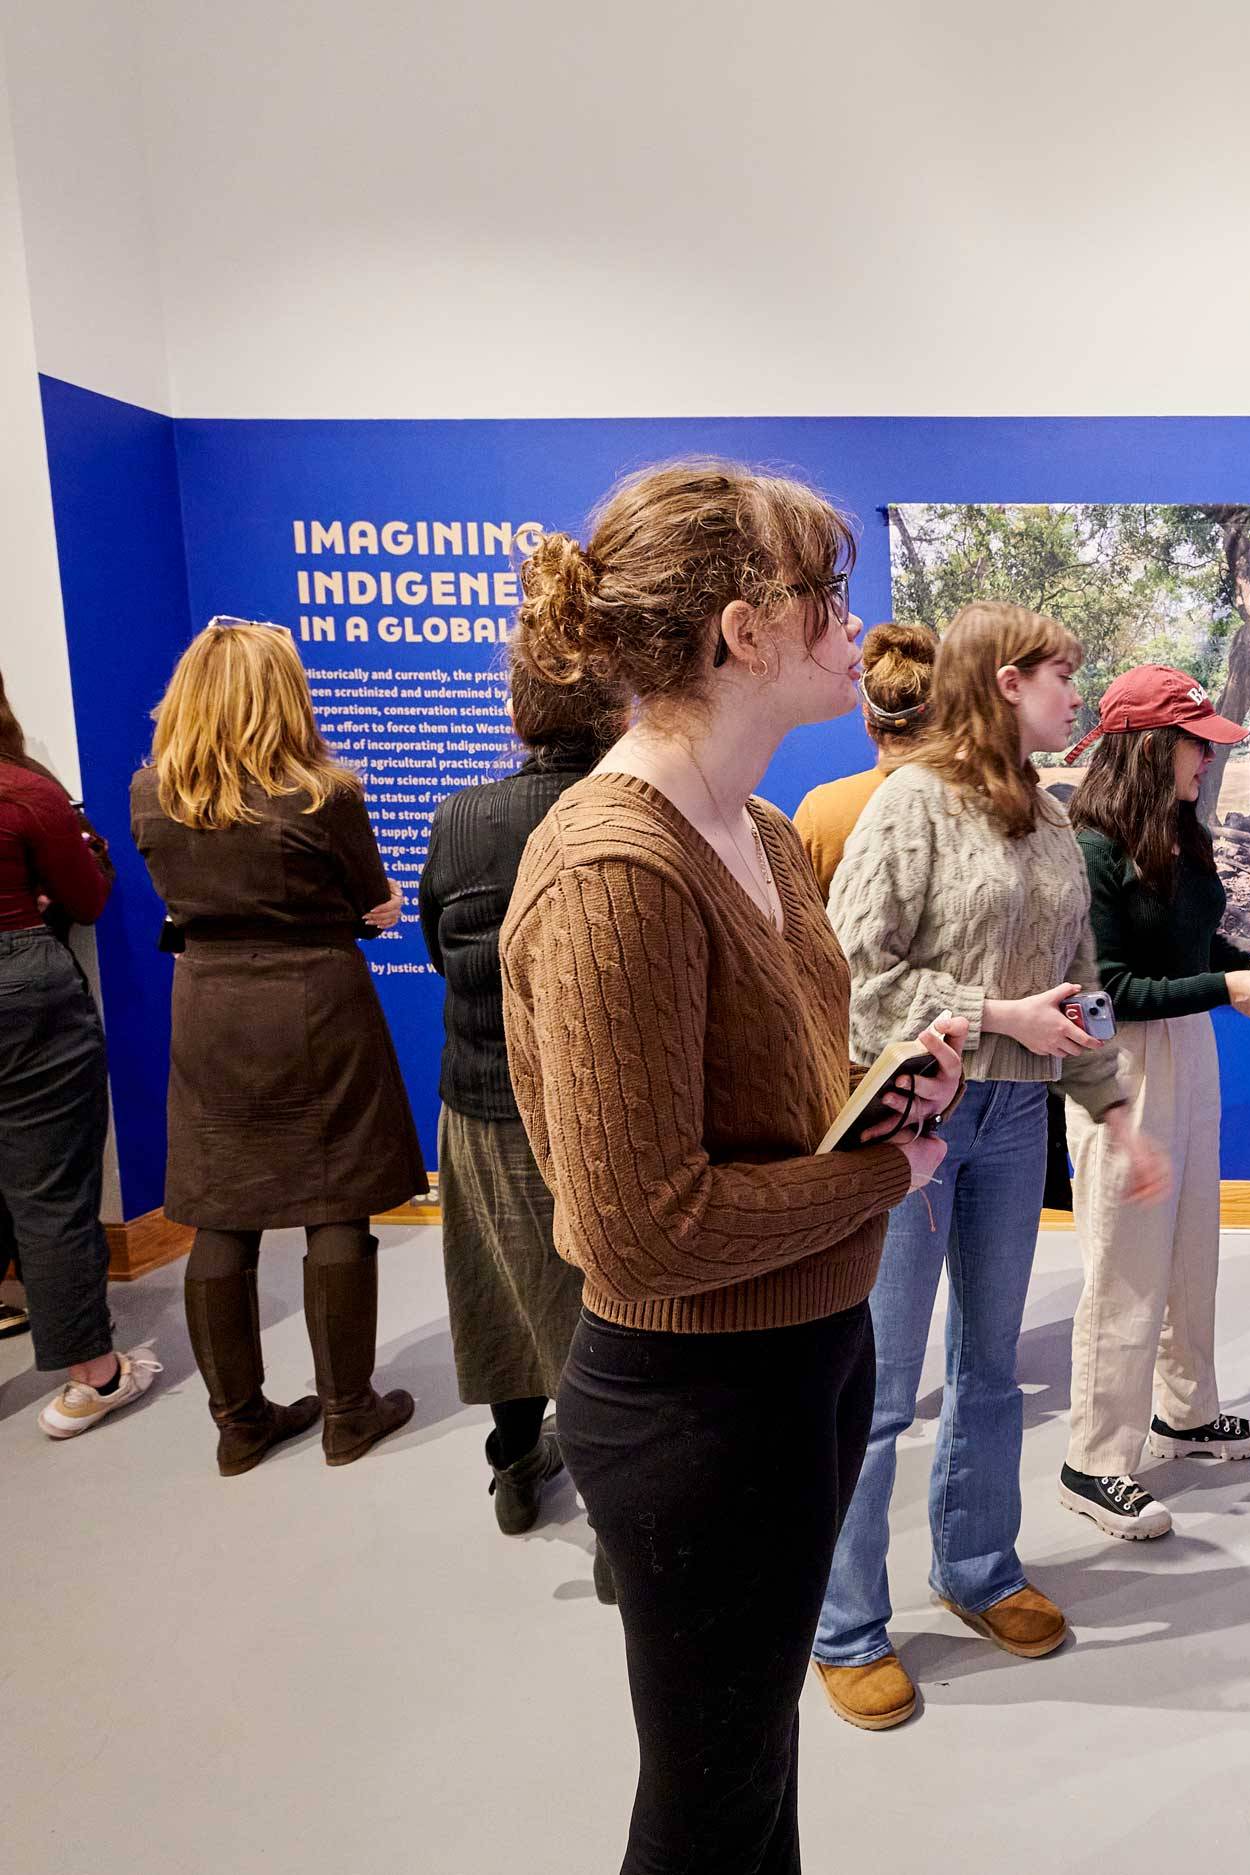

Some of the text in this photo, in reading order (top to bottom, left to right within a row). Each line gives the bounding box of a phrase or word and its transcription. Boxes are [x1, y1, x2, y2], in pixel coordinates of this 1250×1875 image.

[293, 520, 544, 555] IMAGINING
[297, 571, 519, 606] INDIGENE
[301, 616, 508, 643] IN A GLOBAL
[304, 668, 369, 682] Historically
[371, 668, 393, 680] and
[395, 669, 450, 683] currently,
[453, 669, 472, 681] the
[334, 686, 398, 698] scrutinized
[400, 686, 421, 698] and
[424, 687, 492, 699] undermined
[494, 688, 508, 701] by
[383, 705, 457, 716] conservation
[321, 723, 335, 732] an
[337, 721, 369, 733] effort
[372, 723, 385, 733] to
[387, 721, 416, 733] force
[419, 722, 448, 733] them
[450, 723, 474, 733] into
[353, 738, 366, 750] of
[367, 739, 445, 754] incorporating
[446, 740, 508, 754] Indigenous
[370, 757, 436, 771] agricultural
[439, 758, 490, 771] practices
[492, 758, 514, 769] and
[370, 773, 394, 785] how
[397, 774, 438, 786] science
[440, 775, 478, 786] should
[380, 793, 416, 802] status
[418, 791, 431, 802] of
[382, 808, 396, 819] be
[398, 810, 434, 823] strong
[381, 826, 419, 840] supply
[377, 843, 428, 857] large-sca
[371, 962, 385, 975] by
[387, 962, 425, 975] Justice
